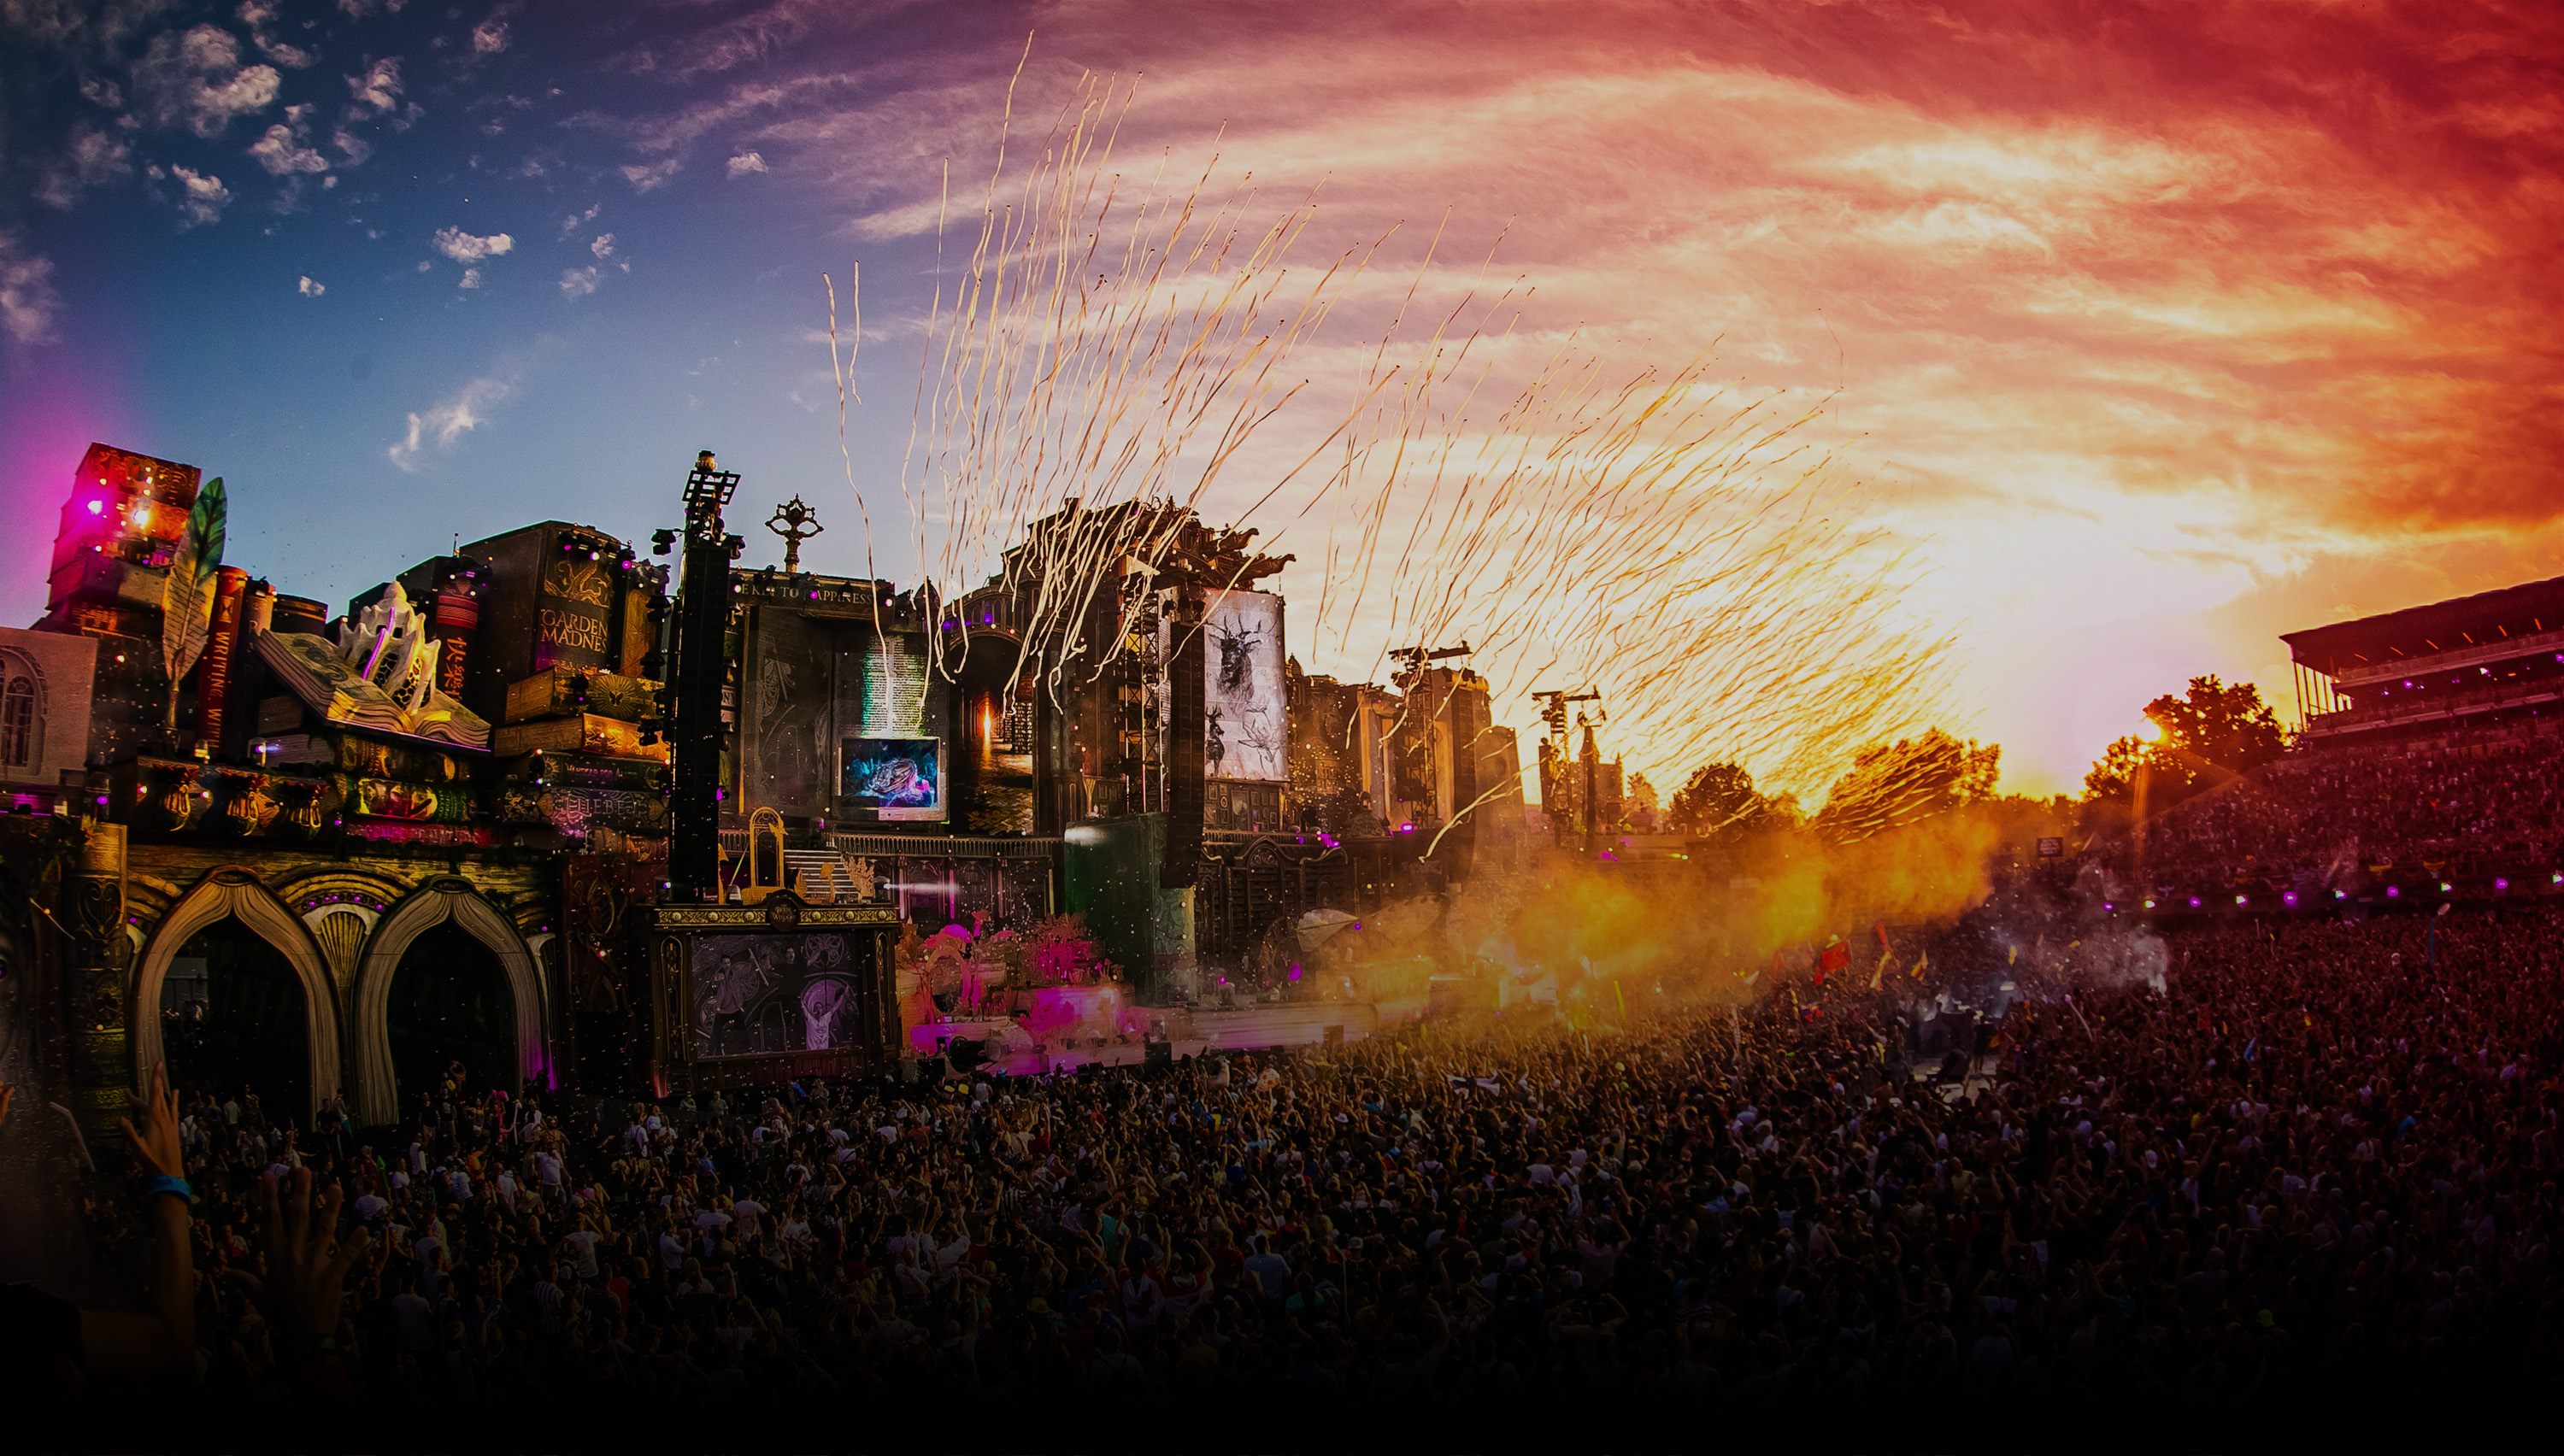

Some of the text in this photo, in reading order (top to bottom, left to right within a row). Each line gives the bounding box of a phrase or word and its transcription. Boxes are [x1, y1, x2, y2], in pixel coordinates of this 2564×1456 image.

[779, 586, 800, 598] TO
[541, 609, 609, 638] GARDEN
[209, 631, 231, 697] WRITING
[577, 798, 626, 818] LIEBE
